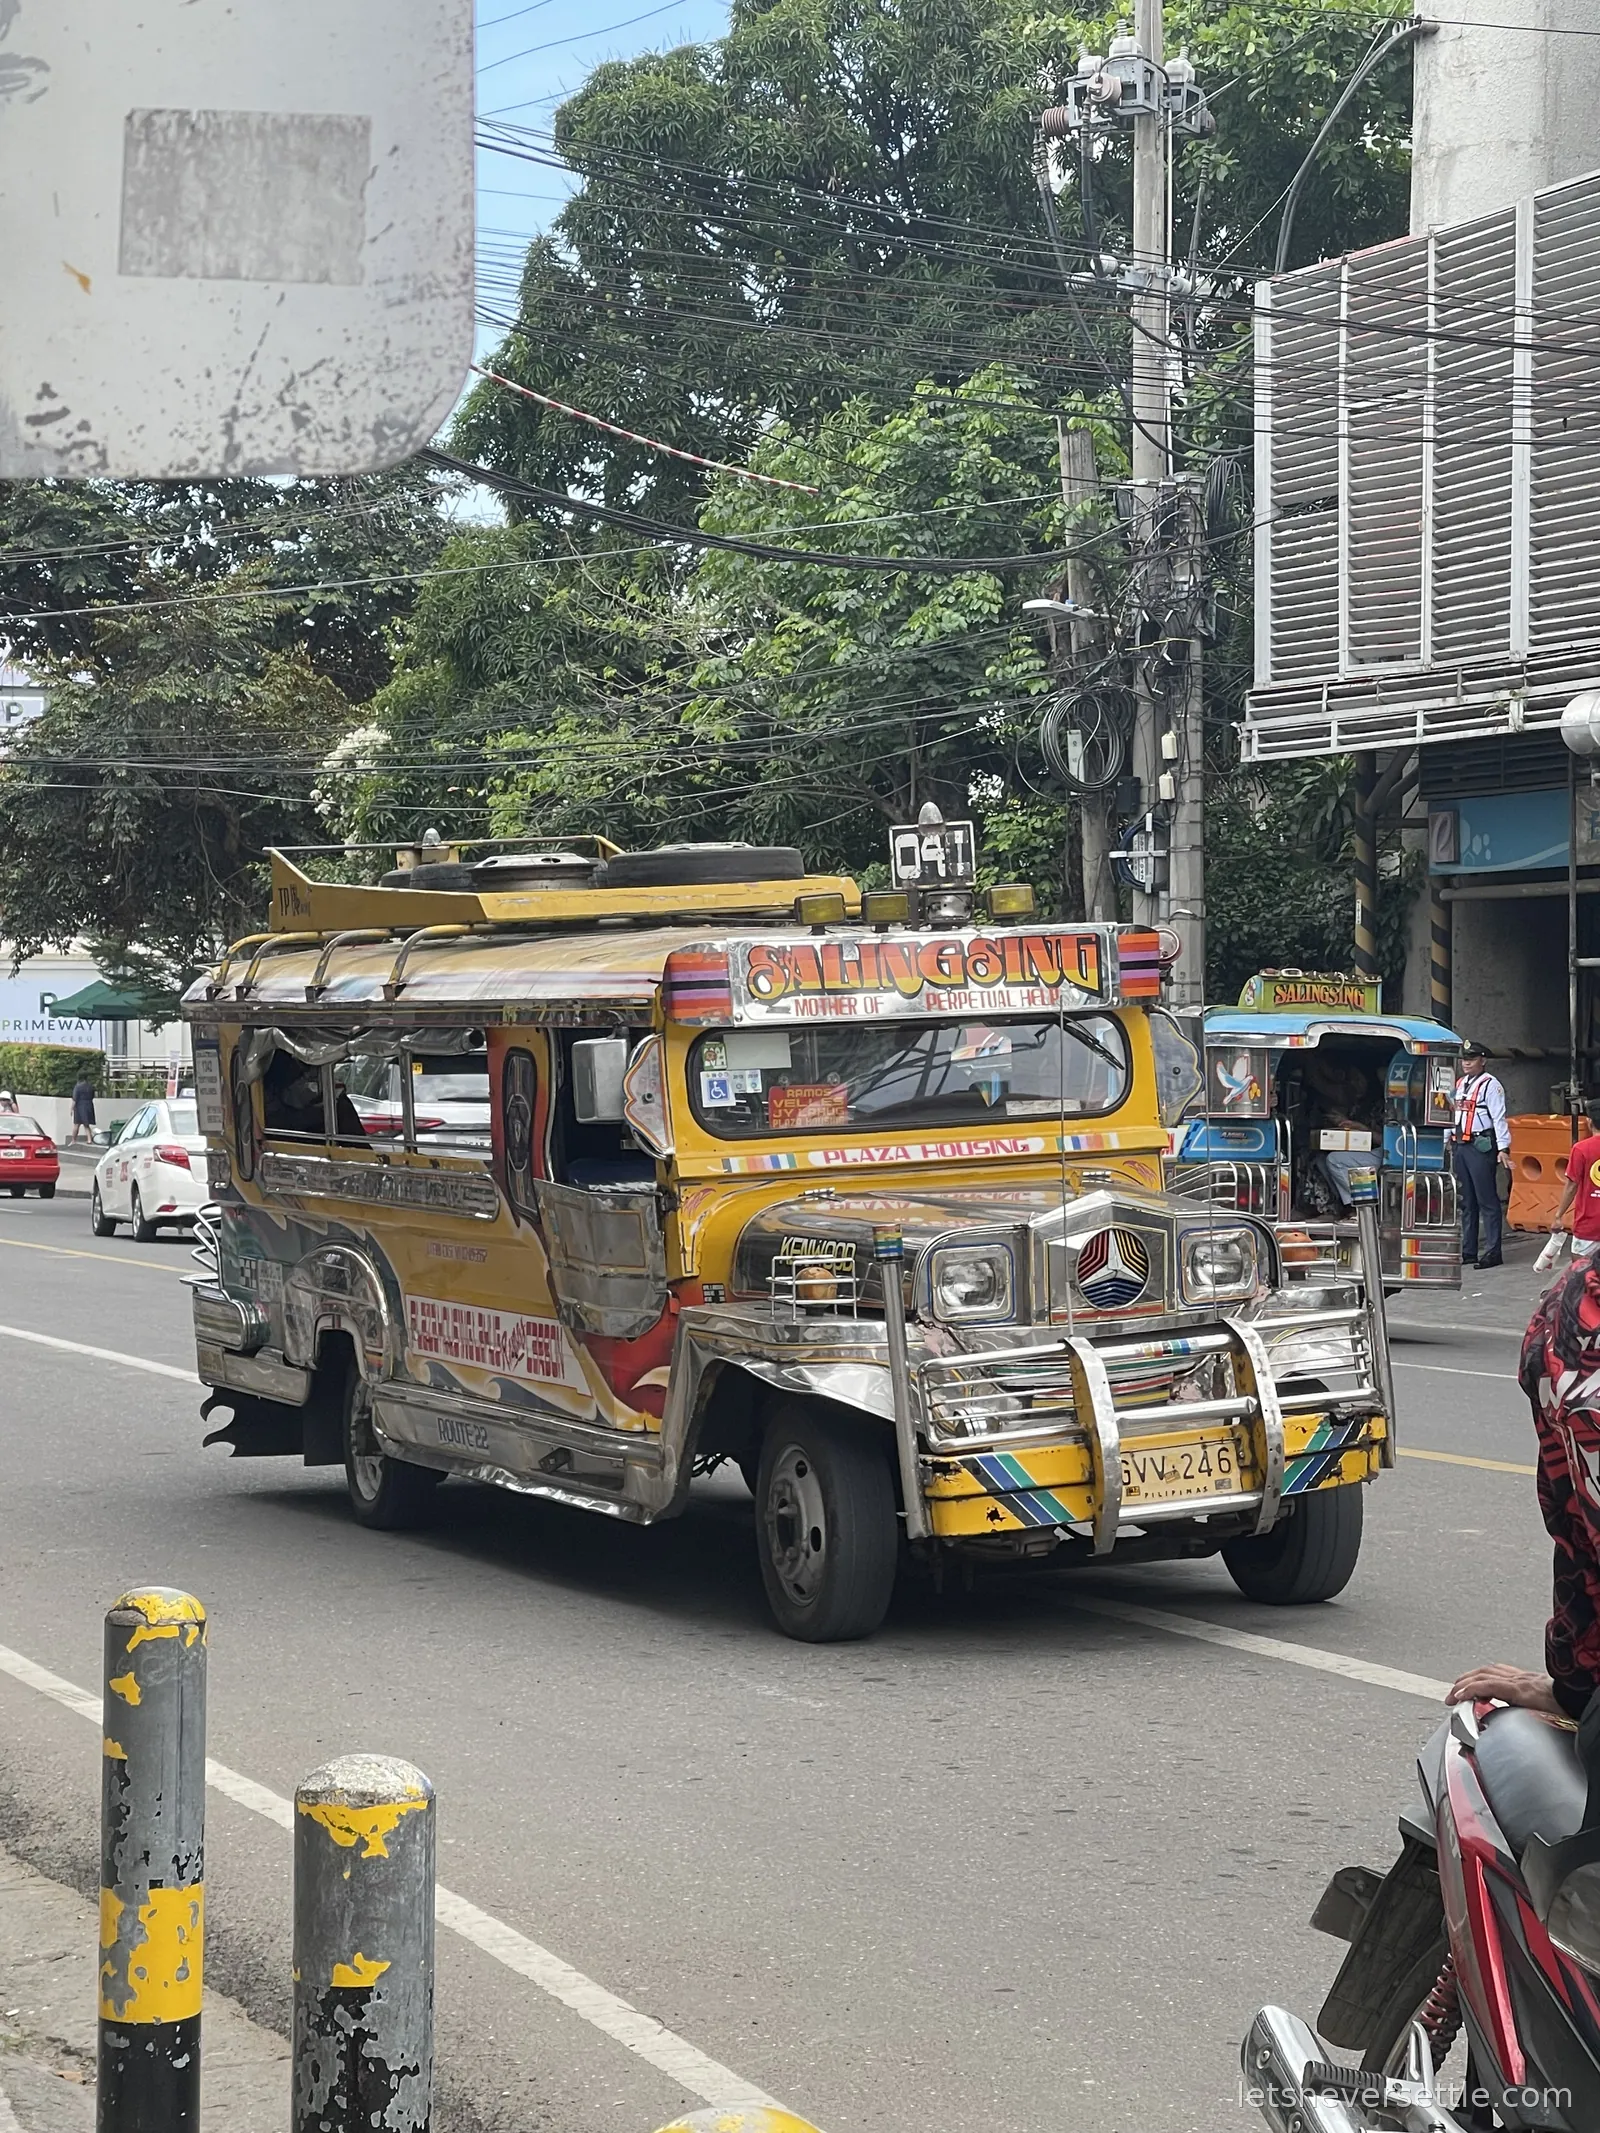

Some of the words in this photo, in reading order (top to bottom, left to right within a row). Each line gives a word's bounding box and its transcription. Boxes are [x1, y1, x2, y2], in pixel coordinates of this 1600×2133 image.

[748, 933, 1100, 1000] SALINGSING
[795, 996, 857, 1017] MOTHER
[864, 994, 884, 1014] OF
[926, 989, 1013, 1012] PERPETUAL
[1021, 987, 1060, 1007] HELP
[1274, 982, 1365, 1012] SALINGSING
[2, 1019, 95, 1031] PRIMEWAY
[786, 1088, 832, 1099] RAMOS
[773, 1108, 794, 1118] JY
[823, 1144, 911, 1165] PLAZA
[921, 1138, 1030, 1159] HOUSING
[780, 1236, 857, 1272] KENWOOD
[1181, 1446, 1232, 1480] 246
[1144, 1485, 1209, 1499] PILIPINAS
